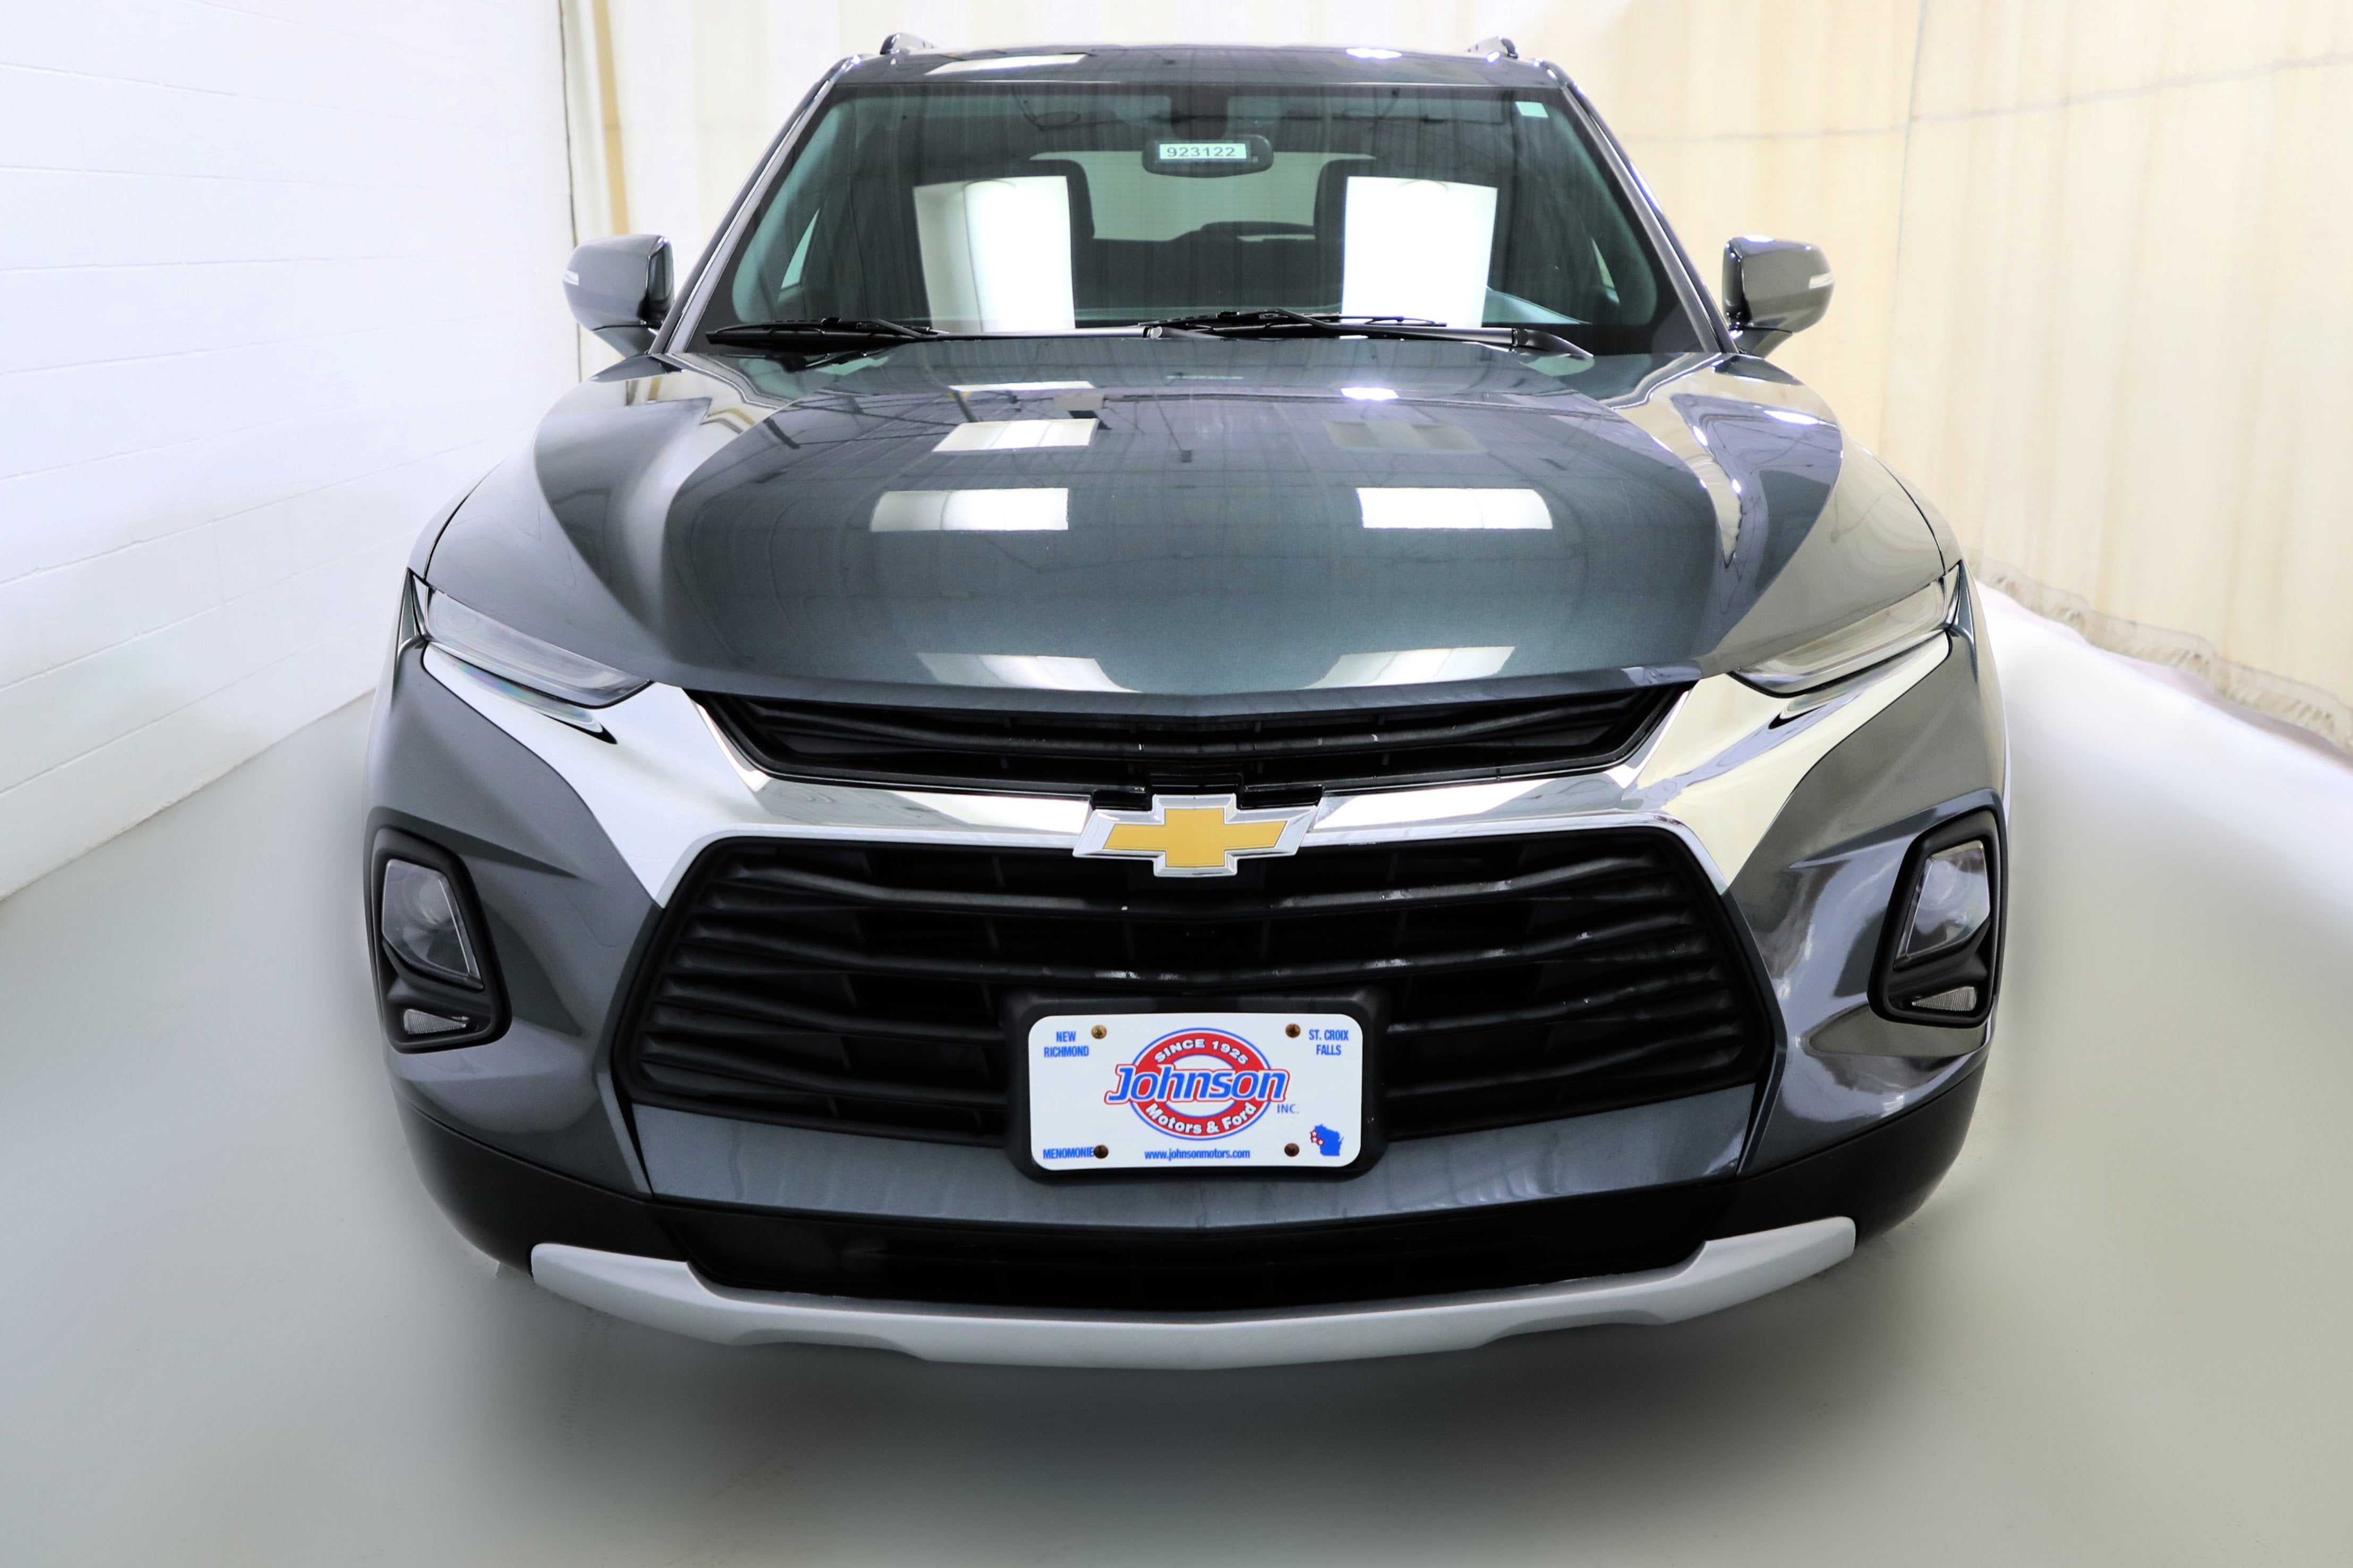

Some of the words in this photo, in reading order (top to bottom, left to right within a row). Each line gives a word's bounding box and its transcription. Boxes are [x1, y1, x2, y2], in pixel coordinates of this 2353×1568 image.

[1167, 147, 1236, 157] 923122
[1056, 1031, 1076, 1042] NEW
[1309, 1029, 1322, 1040] ST.
[1324, 1030, 1349, 1041] CROIX
[1044, 1046, 1089, 1057] RICHMOND
[1154, 1039, 1205, 1063] SINCE
[1212, 1040, 1249, 1065] 1925
[1316, 1044, 1342, 1056] FALLS
[1106, 1065, 1289, 1103] Johnson
[1277, 1104, 1299, 1114] INC.
[1145, 1103, 1203, 1134] Motors
[1206, 1121, 1220, 1134] &
[1222, 1102, 1257, 1130] Ford
[1043, 1147, 1094, 1159] MENOMONIE
[1144, 1148, 1250, 1161] www.johnsonmotors.com
